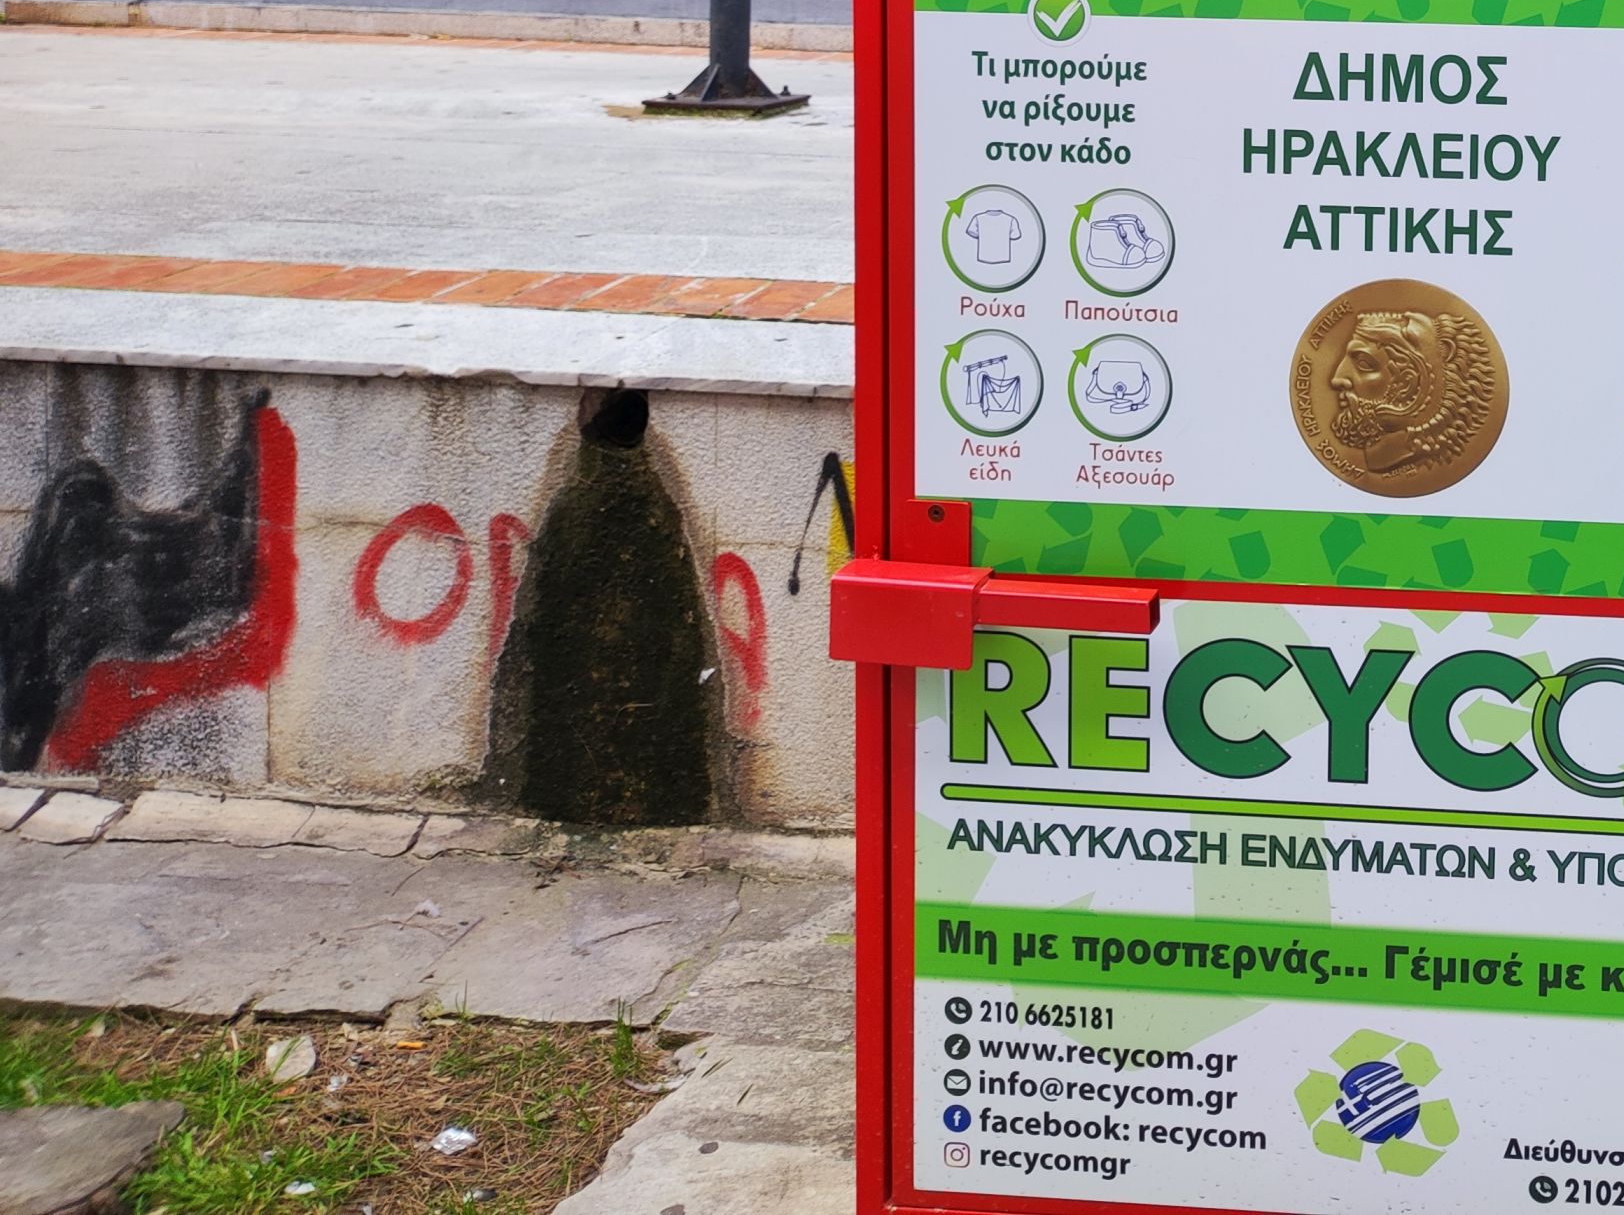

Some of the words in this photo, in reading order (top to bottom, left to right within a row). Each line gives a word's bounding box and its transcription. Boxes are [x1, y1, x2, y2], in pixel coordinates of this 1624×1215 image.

[971, 50, 996, 78] Τι
[1004, 53, 1148, 87] μπορούμε
[1292, 51, 1508, 106] ΔΗΜΟΣ
[982, 98, 1016, 121] να
[1024, 93, 1136, 129] ρίξουμε
[985, 140, 1053, 163] στον
[1060, 137, 1132, 165] κάδο
[1243, 127, 1562, 182] ΗΡΑΚΛΕΙΟΥ
[1282, 204, 1514, 256] ΑΤΤΙΚΗΣ
[960, 295, 1026, 318] Ρούχα
[1064, 299, 1179, 323] Παπούτσια
[960, 438, 1022, 458] Λευκά
[1089, 442, 1163, 464] Τσάντες
[969, 461, 1012, 482] είδη
[1076, 464, 1175, 492] Αξεσουάρ
[947, 818, 1228, 865] ΑΝΑΚΥΚΛΩΣΗ
[1241, 833, 1497, 880] ΕΝΔΥΜΑΤΩΝ
[1508, 847, 1538, 883] &
[937, 918, 998, 966] Μη
[1013, 931, 1060, 967] με
[1072, 935, 1369, 985] προσπερνάς...
[1384, 944, 1523, 992] Γέμισέ
[1538, 962, 1586, 997] με
[980, 1000, 1019, 1025] 210
[1024, 1003, 1115, 1030] 6625181
[978, 1039, 1239, 1079] www.recycom.gr
[978, 1070, 1239, 1116] info@recycom.gr
[979, 1107, 1130, 1142] facebook:
[1138, 1123, 1268, 1152] recycom
[979, 1147, 1132, 1181] recycomgr
